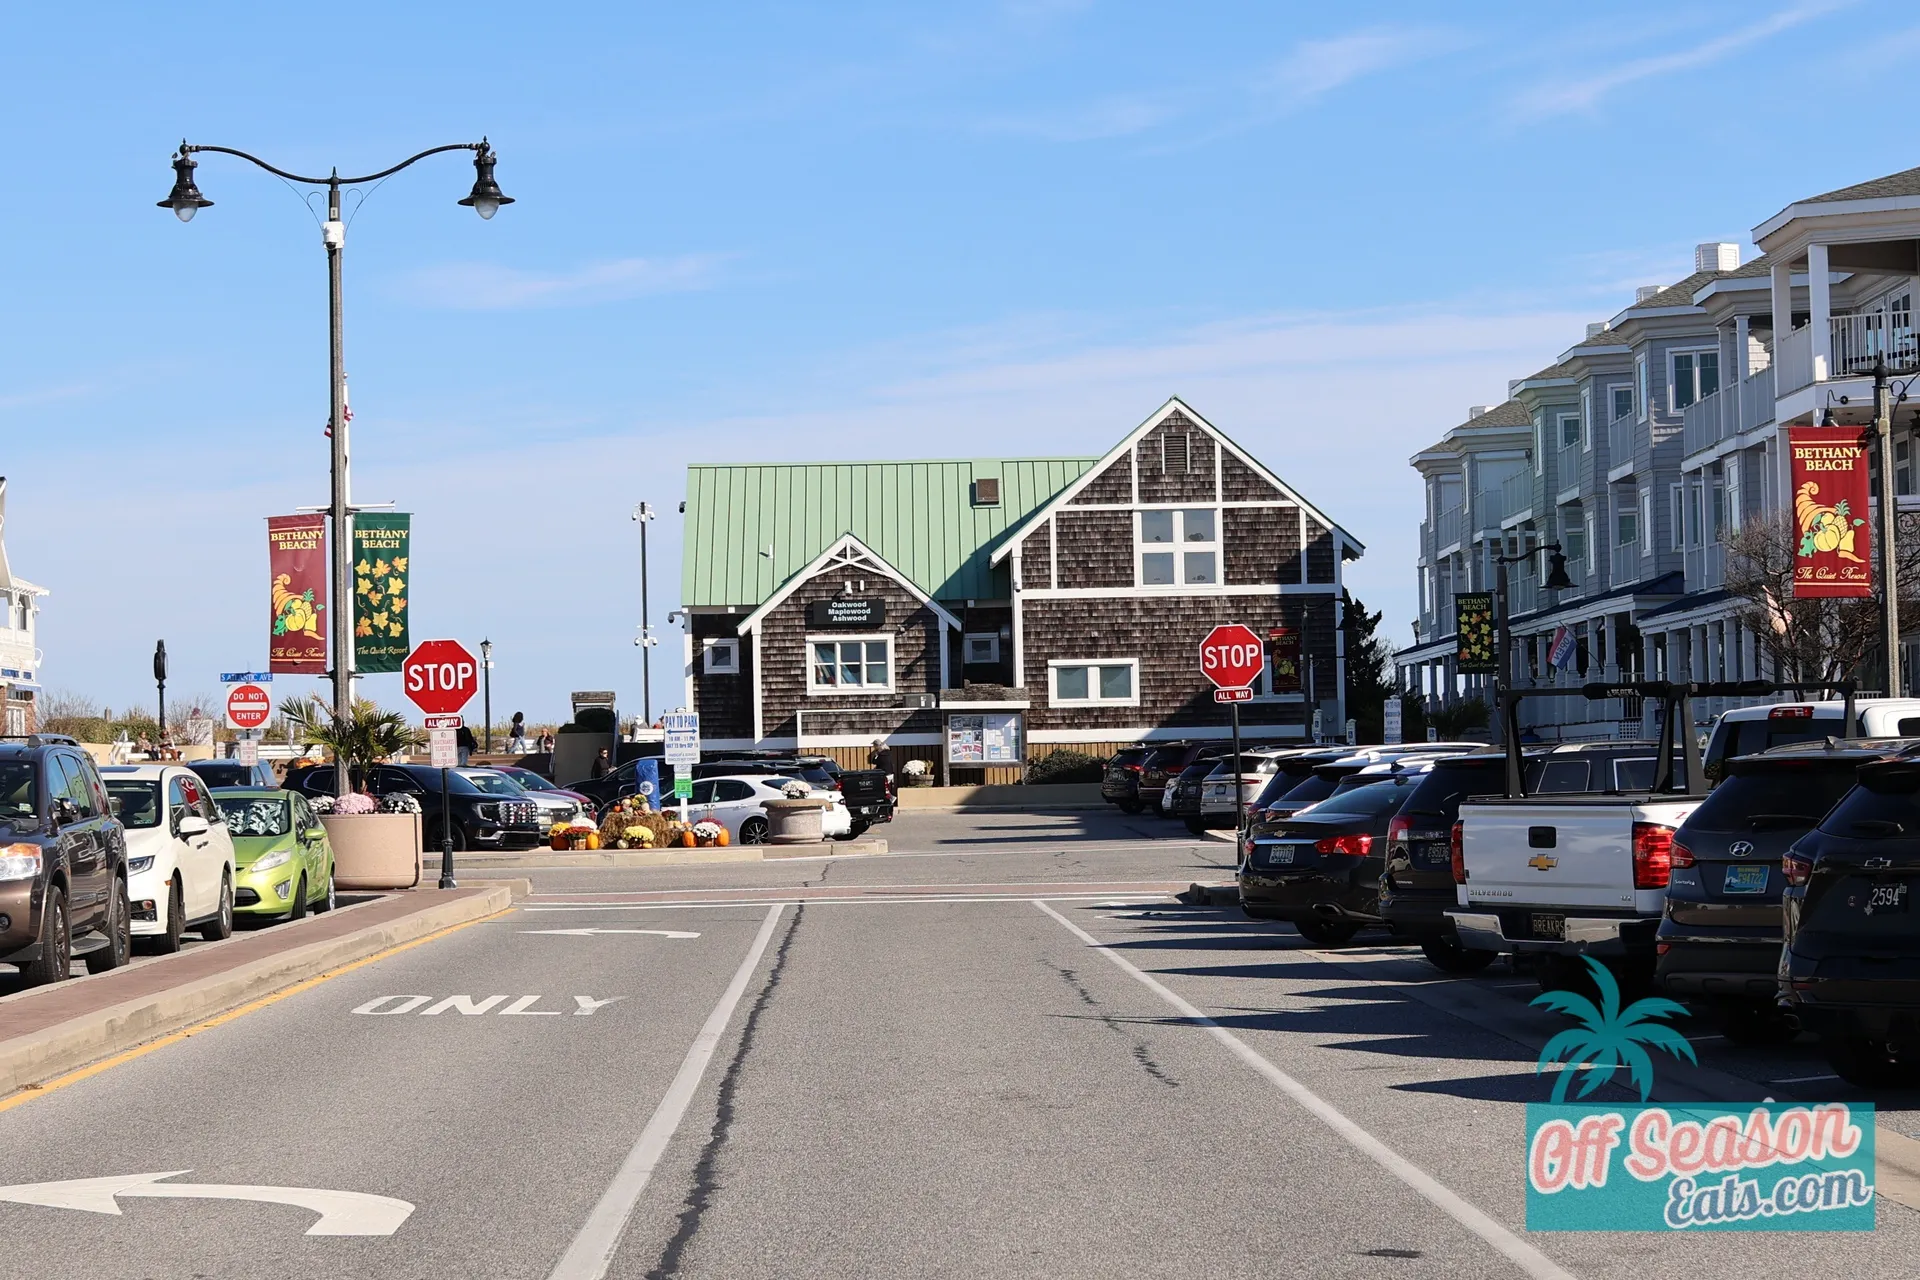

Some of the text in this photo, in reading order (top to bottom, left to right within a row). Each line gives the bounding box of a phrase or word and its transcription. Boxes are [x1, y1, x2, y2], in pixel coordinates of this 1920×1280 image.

[1795, 447, 1862, 458] BETHANY
[1805, 460, 1854, 471] BEACH
[270, 530, 324, 541] BETHANY
[354, 530, 408, 538] BETHANY
[279, 541, 316, 550] BEACH
[362, 540, 400, 548] BEACH
[1796, 566, 1867, 579] The Quiet Resort
[271, 648, 284, 657] The
[356, 646, 408, 654] The Quiet Resort
[1204, 644, 1259, 669] STOP
[408, 662, 473, 691] STOP
[1234, 691, 1249, 699] WAY
[666, 715, 698, 728] PAY TO PARK
[1872, 888, 1899, 905] 2594
[1534, 920, 1565, 932] BREAKRS
[350, 994, 627, 1015] ONLY
